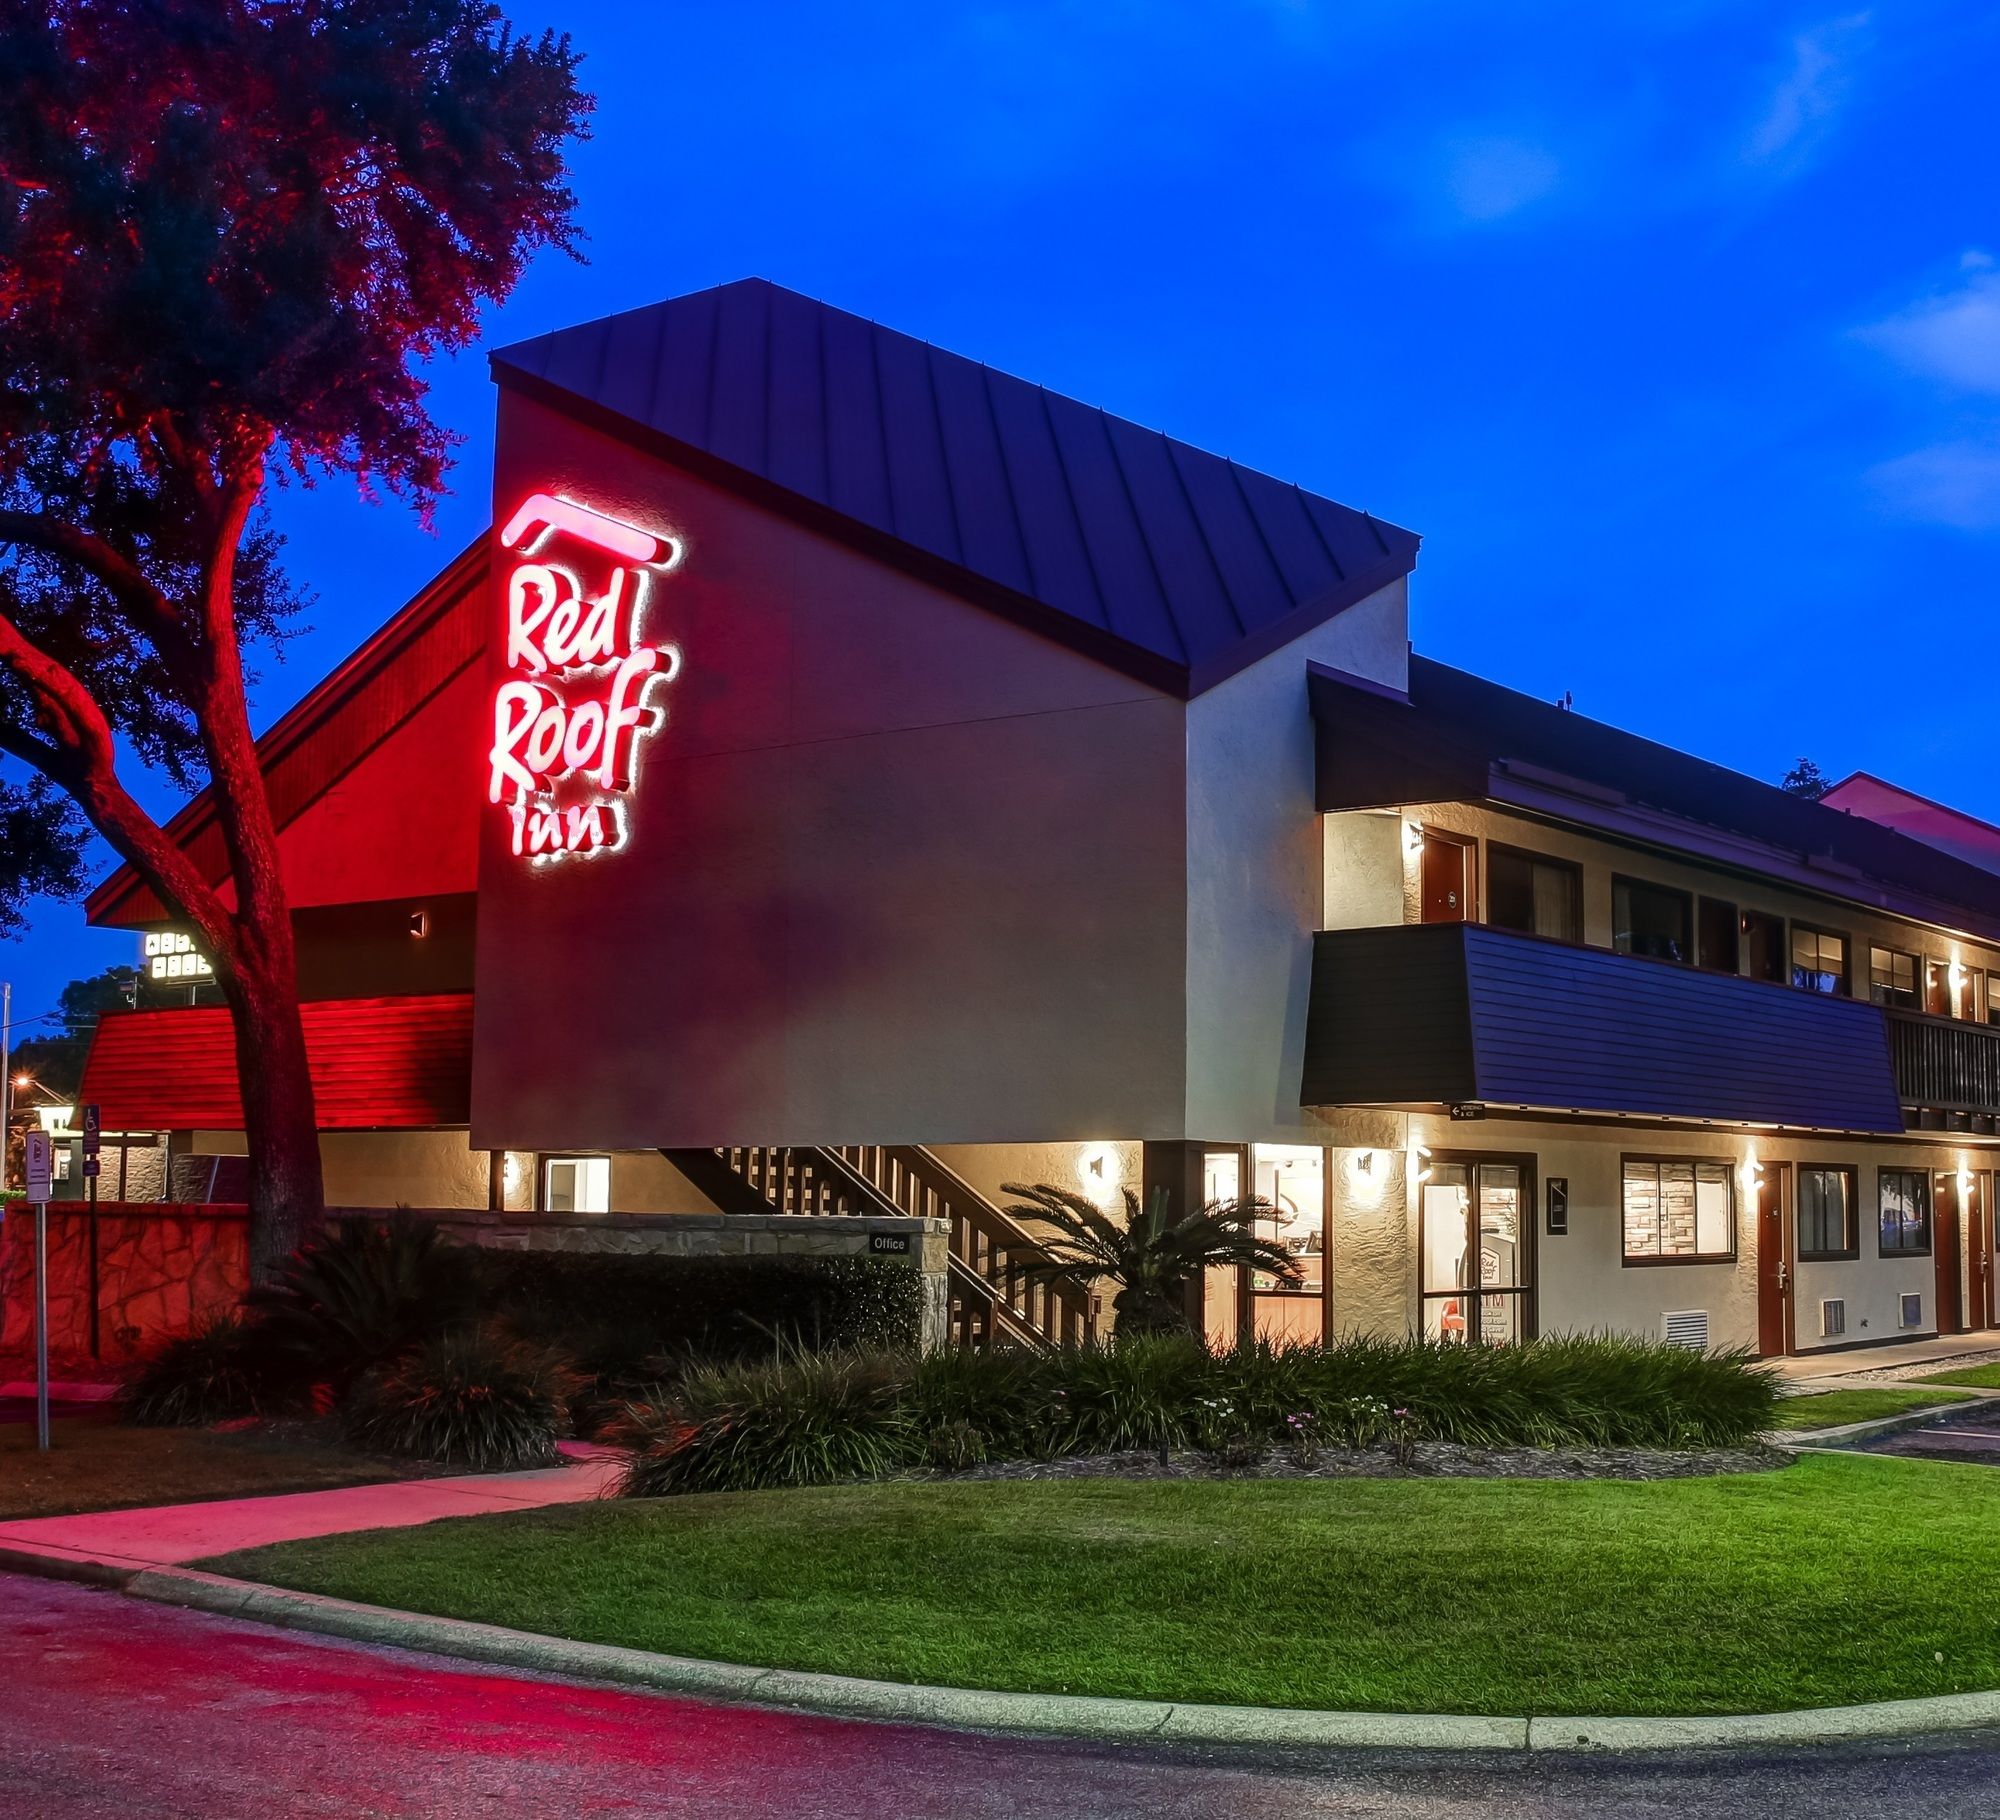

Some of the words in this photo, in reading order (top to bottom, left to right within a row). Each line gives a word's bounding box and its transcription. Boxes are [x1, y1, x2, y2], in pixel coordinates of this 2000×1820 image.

[507, 563, 625, 673] Red
[489, 647, 657, 803] Roof
[874, 1237, 905, 1249] Office
[1481, 1293, 1504, 1307] TM
